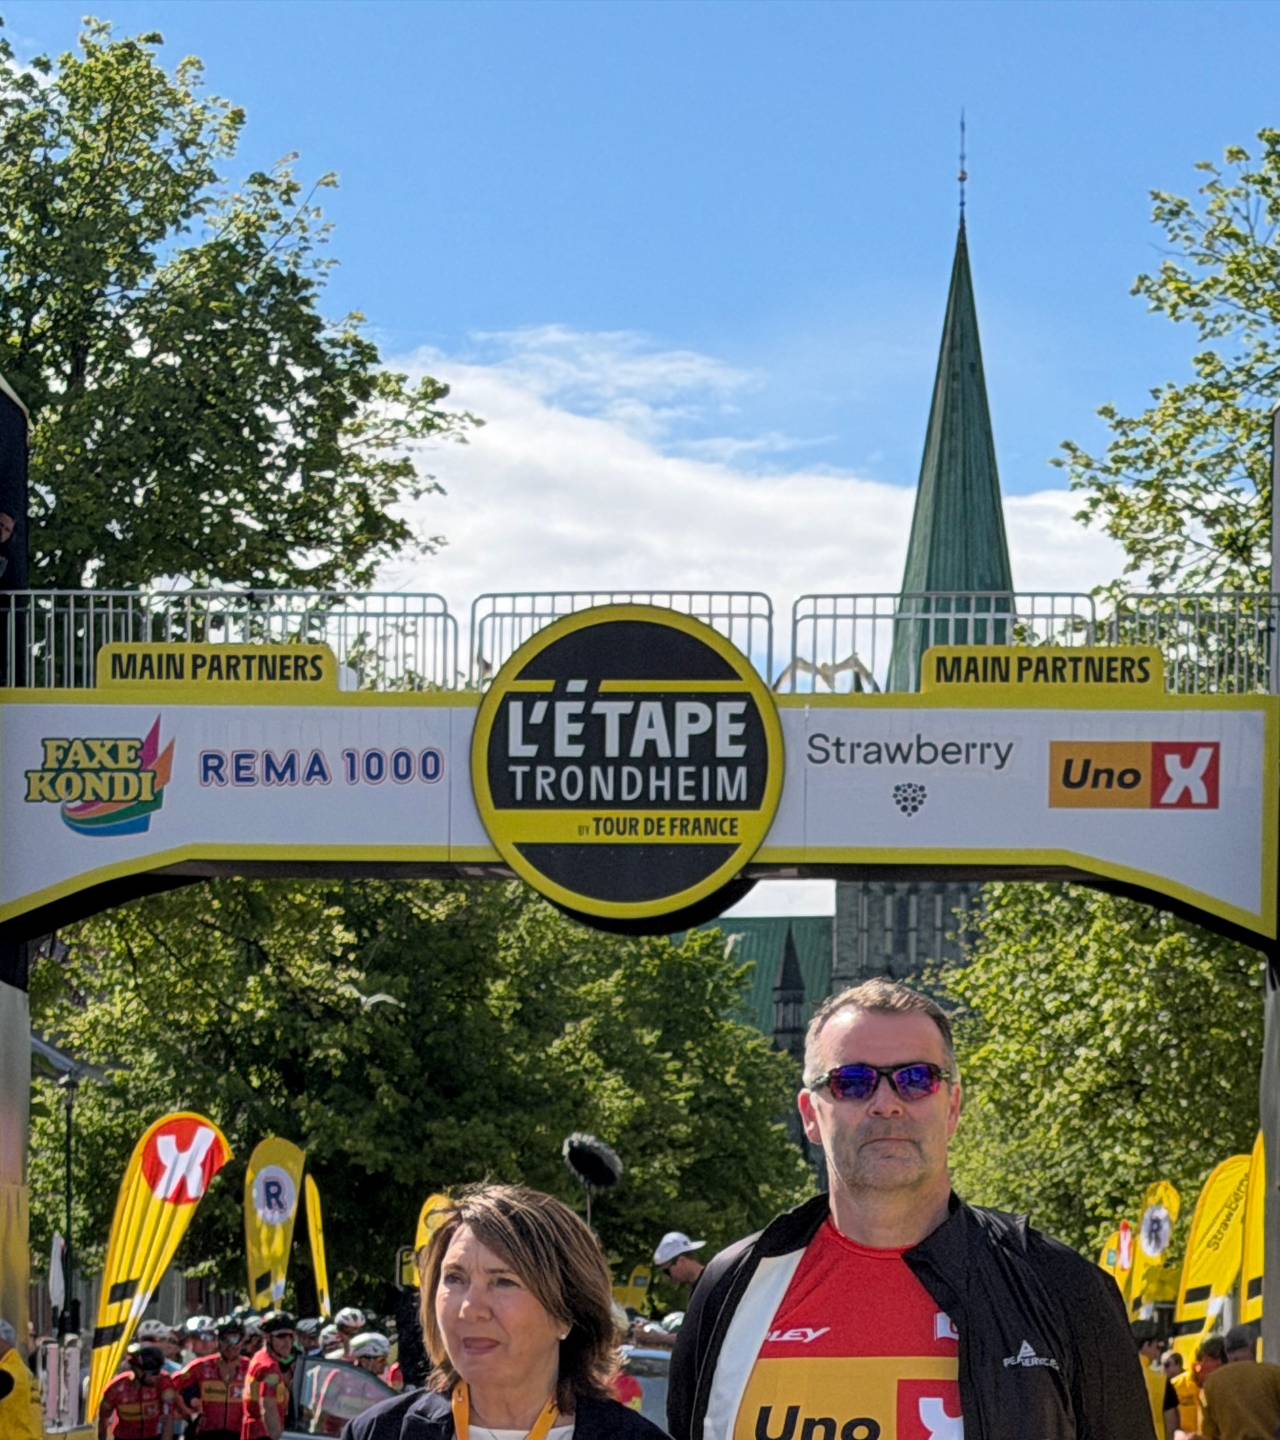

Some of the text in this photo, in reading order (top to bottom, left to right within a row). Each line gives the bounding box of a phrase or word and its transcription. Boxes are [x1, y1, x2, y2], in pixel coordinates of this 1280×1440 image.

[111, 653, 324, 681] MAIN PARTNERS
[935, 656, 1151, 683] MAIN PARTNERS
[41, 738, 144, 770] FAXE
[199, 747, 445, 787] REMA 1000
[806, 733, 1014, 770] Strawberry
[25, 769, 157, 803] KONDI
[507, 766, 748, 801] TRONDHEIM
[1061, 747, 1214, 805] Uno X
[593, 817, 643, 836] TOUR
[644, 817, 666, 836] DE
[669, 817, 739, 836] FRANCE
[156, 1126, 216, 1199] X
[265, 1181, 283, 1211] R
